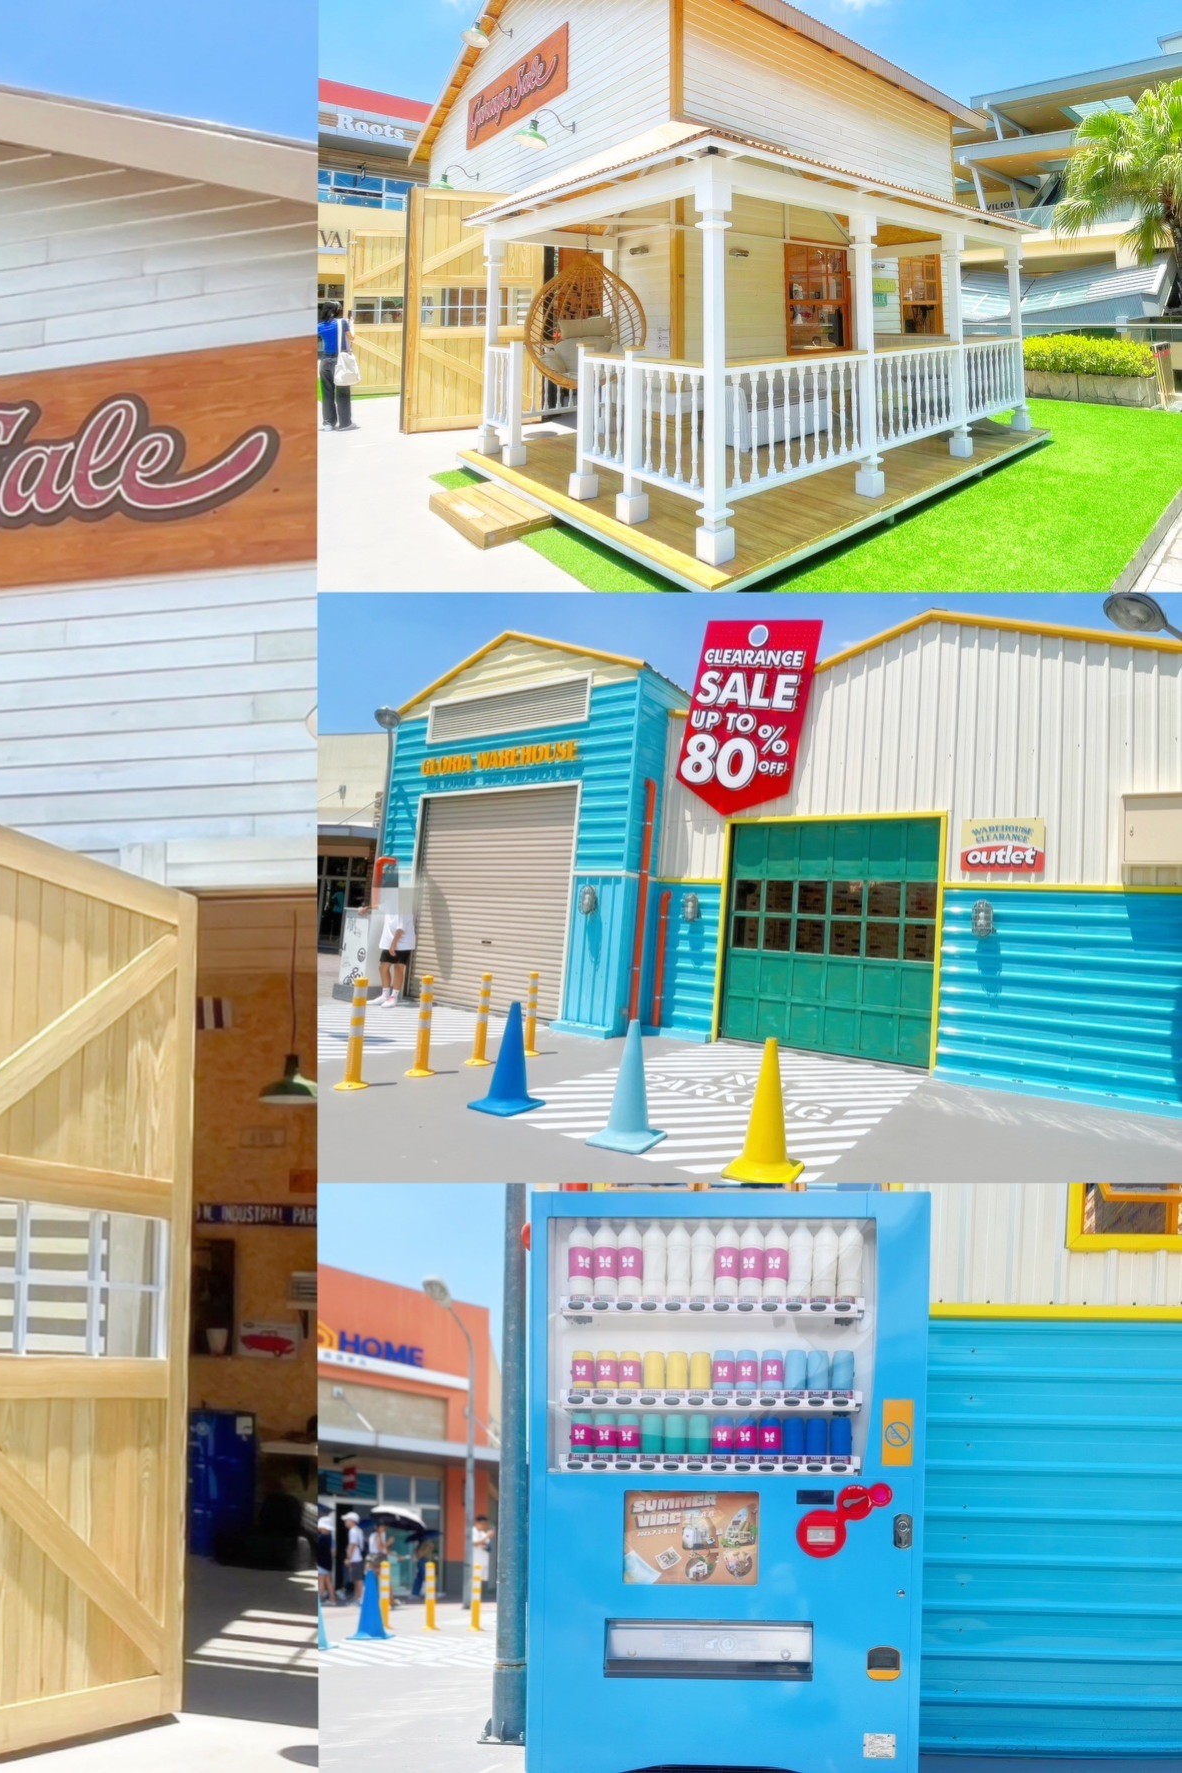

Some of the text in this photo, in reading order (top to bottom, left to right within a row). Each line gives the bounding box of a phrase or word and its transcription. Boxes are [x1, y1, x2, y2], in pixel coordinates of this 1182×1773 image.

[510, 53, 559, 110] Sale
[336, 113, 405, 140] Roots
[704, 648, 805, 668] CLEARANCE
[696, 670, 802, 711] SALE
[691, 710, 756, 732] UP TO
[476, 740, 580, 769] WAREHOUSE
[758, 760, 787, 776] OFF
[971, 824, 1034, 837] WAREHOUSE
[966, 845, 1037, 867] outlet
[339, 1330, 425, 1368] HOME
[632, 1494, 716, 1513] SUMMER
[636, 1511, 682, 1528] VIBE
